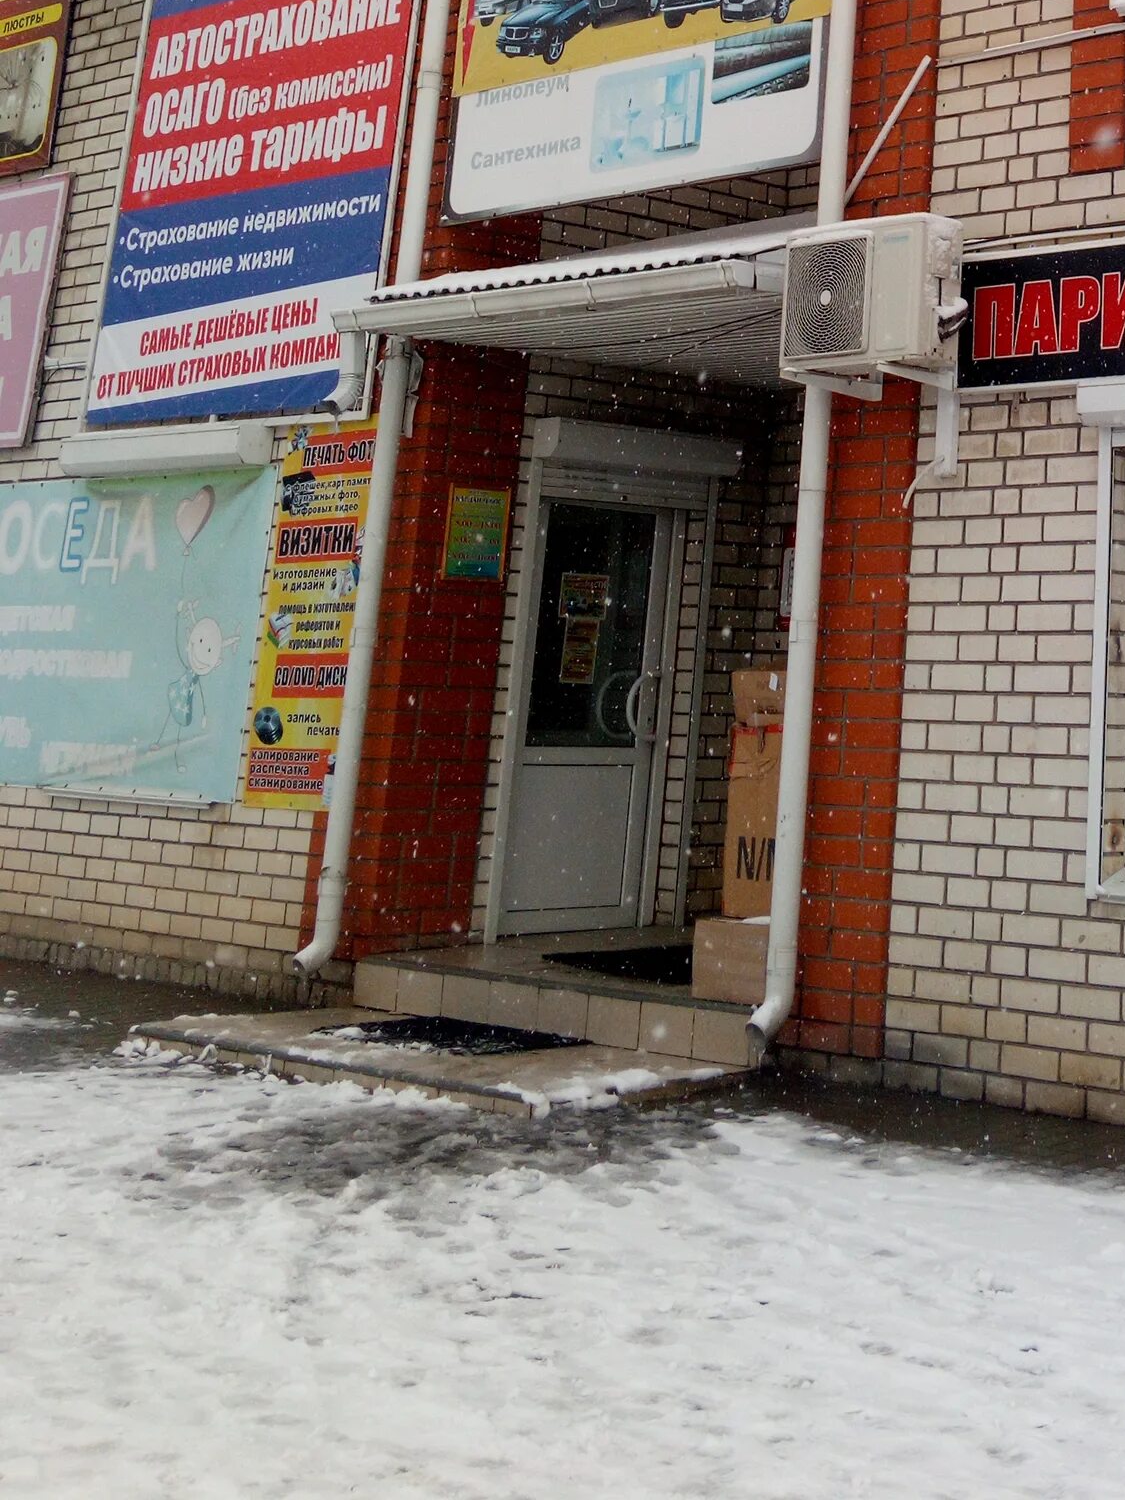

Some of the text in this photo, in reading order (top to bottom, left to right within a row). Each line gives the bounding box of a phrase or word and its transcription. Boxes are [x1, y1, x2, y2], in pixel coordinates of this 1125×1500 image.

[143, 77, 226, 139] ОСАГО
[274, 54, 393, 111] комиссии)
[476, 74, 571, 108] Линолеум
[471, 135, 581, 170] Сантехника
[242, 193, 381, 233] недвижимости
[236, 246, 294, 272] жизни
[139, 297, 318, 357] САМЫЕ ДЕШЁВЫЕ ЦЕНЫ
[96, 373, 116, 400] ОТ
[118, 362, 176, 396] ЛУЧШИХ
[178, 345, 268, 386] СТРАХОВЫХ
[303, 438, 376, 468] ПЕЧАТЬ ФОТ
[278, 522, 355, 558] ВИЗИТКИ
[273, 567, 337, 580] изготовление
[282, 578, 325, 593] и дизайн
[295, 618, 340, 632] рефератов и
[288, 635, 345, 650] курсовых работ
[274, 665, 315, 688] CD/DVD
[287, 711, 322, 724] запись
[250, 749, 320, 764] копирование
[249, 764, 310, 778] распечатка
[248, 776, 324, 791] сканирование
